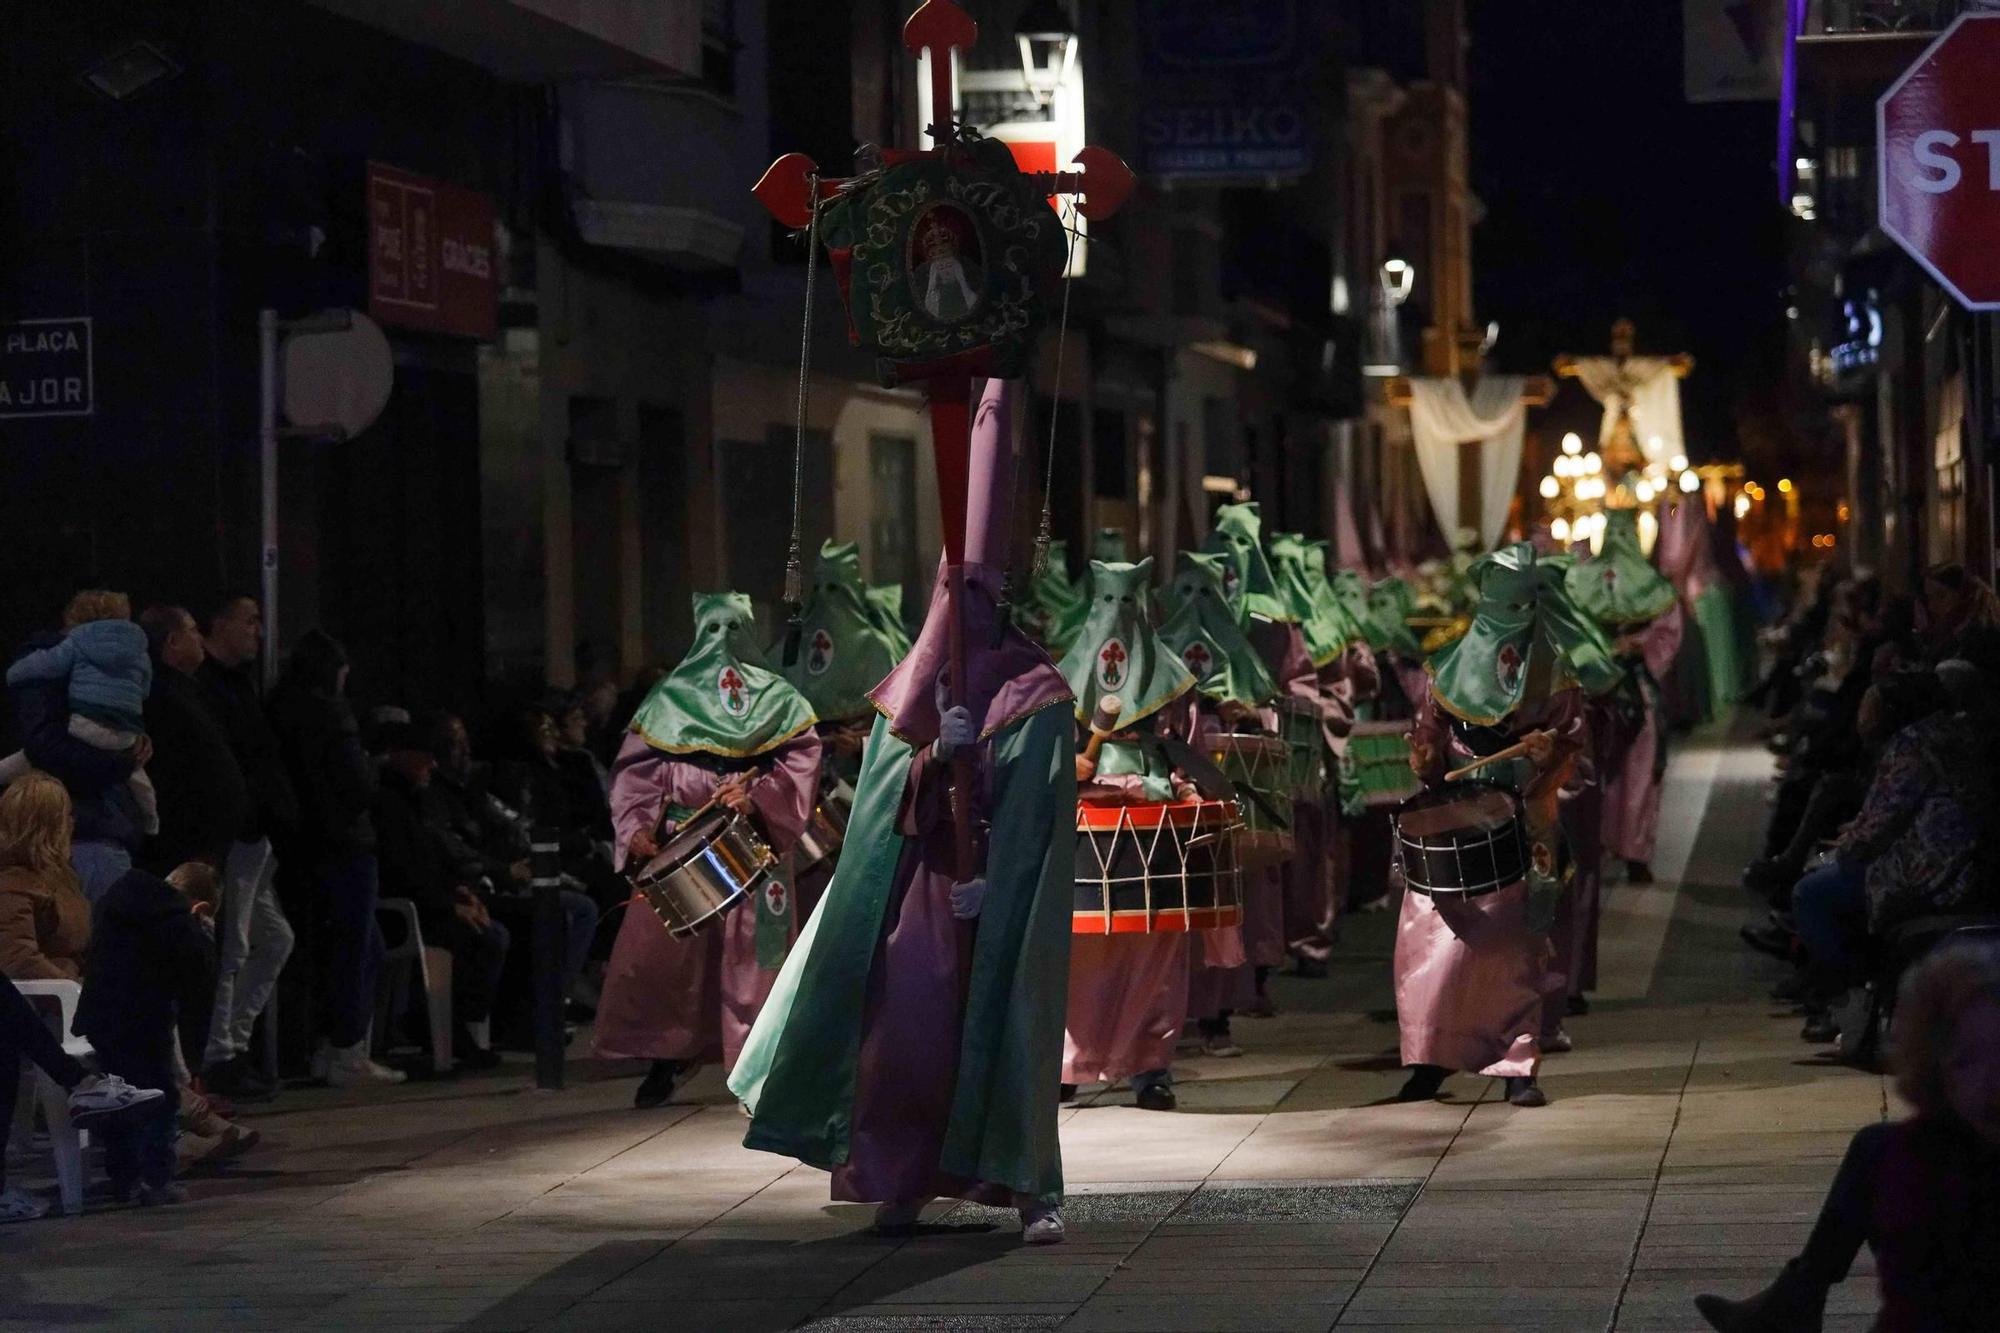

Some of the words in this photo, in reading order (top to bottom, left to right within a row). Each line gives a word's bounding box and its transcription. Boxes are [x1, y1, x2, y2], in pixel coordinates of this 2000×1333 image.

[1143, 106, 1301, 143] SEIKO
[1913, 129, 2000, 193] ST
[7, 330, 79, 355] PLAÇA
